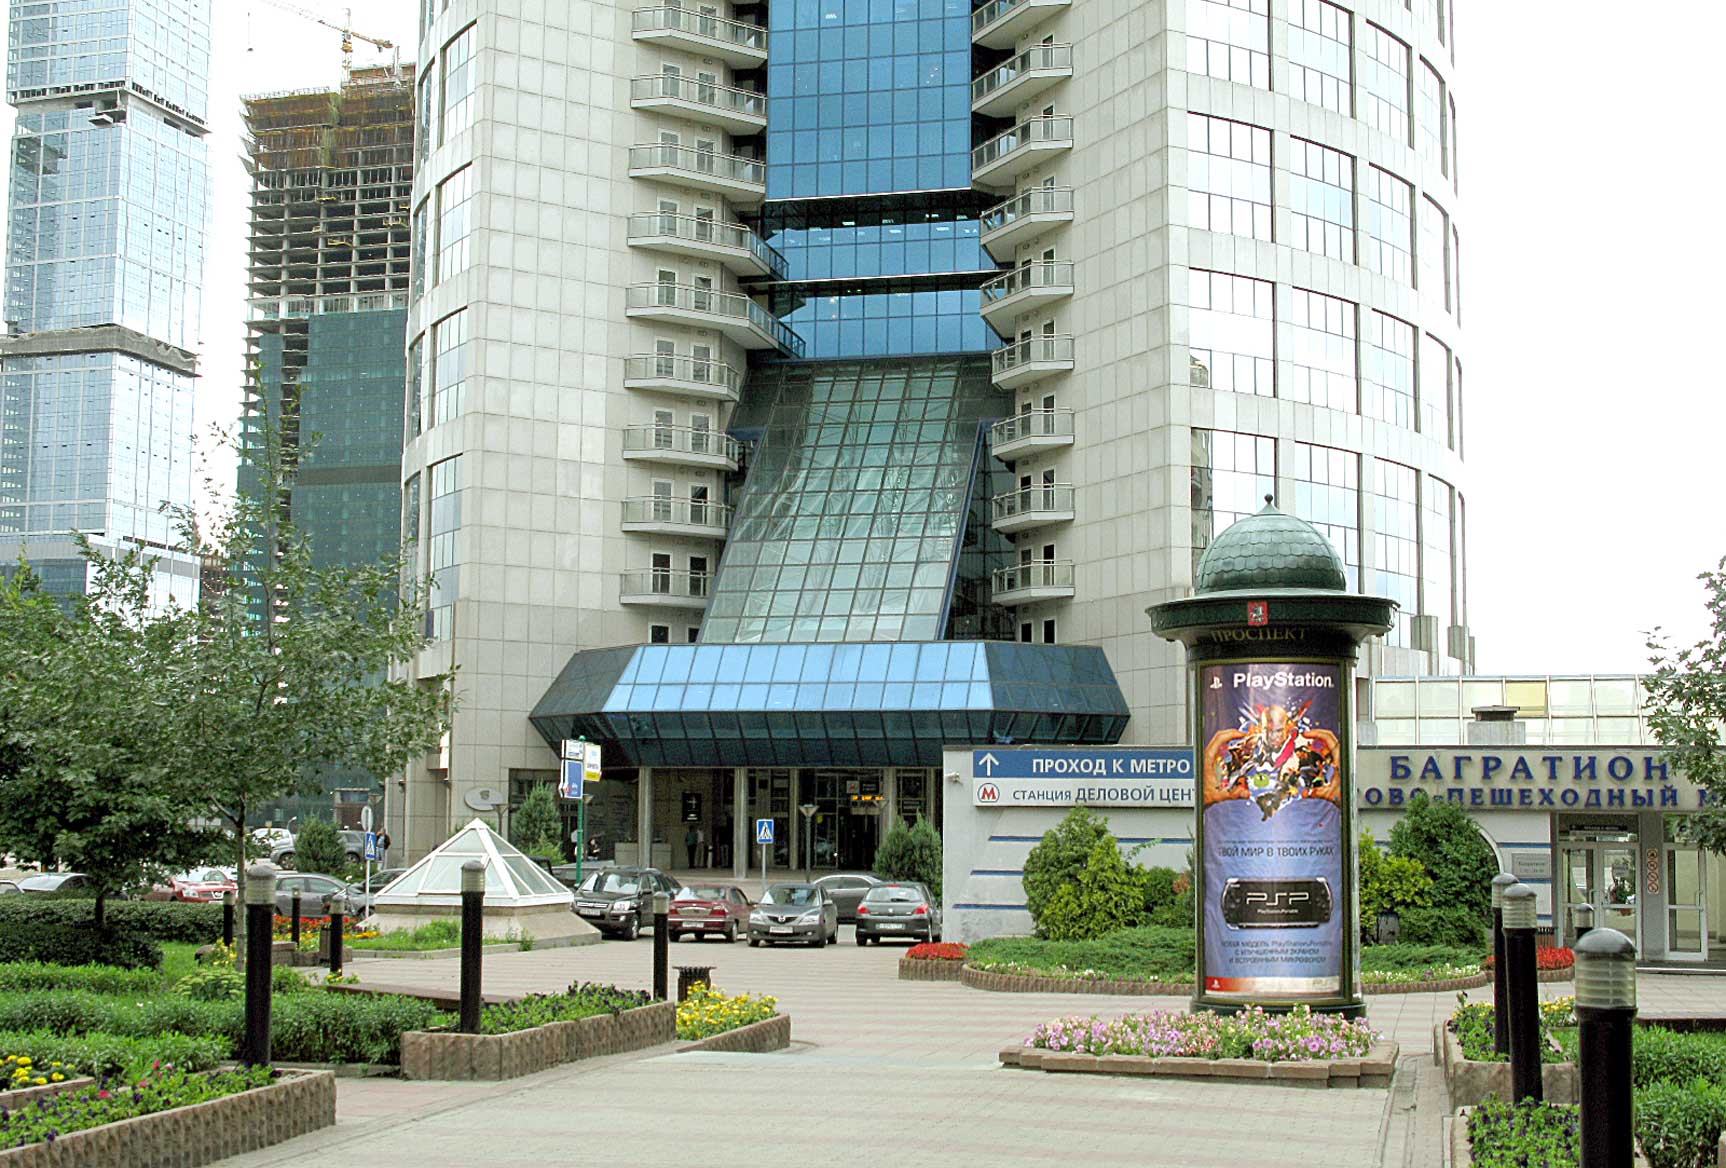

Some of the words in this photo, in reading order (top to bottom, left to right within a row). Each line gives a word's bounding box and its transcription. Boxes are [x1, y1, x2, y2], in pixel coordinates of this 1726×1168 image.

[1210, 628, 1308, 643] ПРОСПЕКТ
[1032, 758, 1107, 776] ПРОХОД
[1112, 758, 1124, 774] К
[1130, 758, 1191, 774] МЕТРО
[1390, 755, 1669, 781] БАГРАТИОН
[1012, 790, 1071, 802] СТАНЦИЯ
[1075, 785, 1155, 804] ДЕЛОВОЙ
[1159, 788, 1195, 803] ЦЕН
[1241, 847, 1264, 857] МИР
[1277, 846, 1308, 857] ТВОИХ
[1246, 892, 1310, 906] PSP
